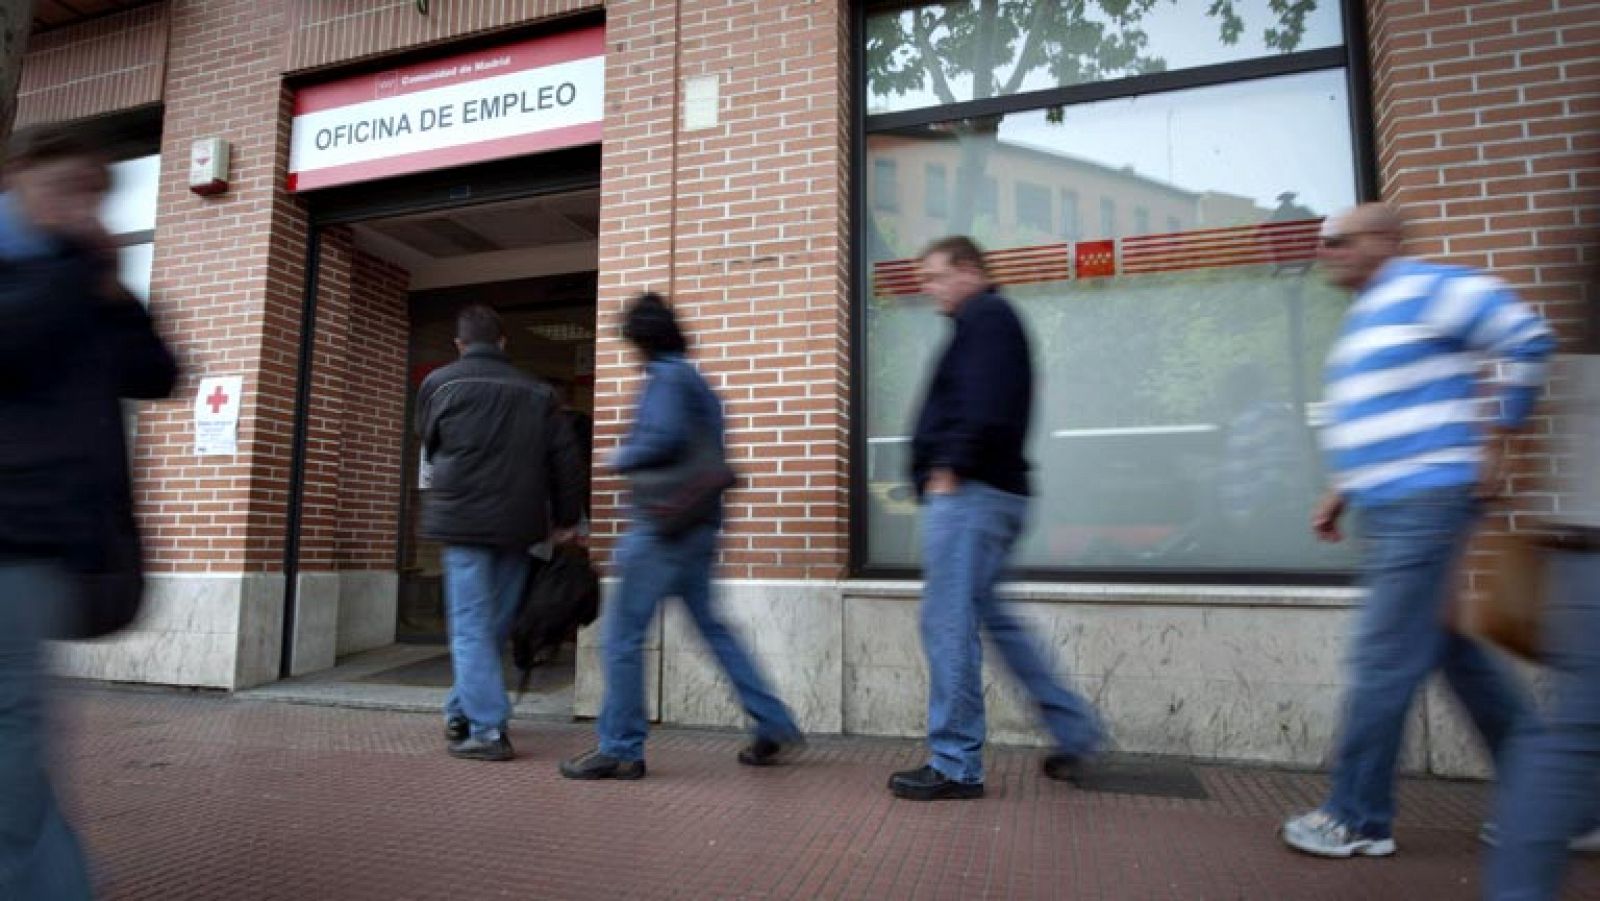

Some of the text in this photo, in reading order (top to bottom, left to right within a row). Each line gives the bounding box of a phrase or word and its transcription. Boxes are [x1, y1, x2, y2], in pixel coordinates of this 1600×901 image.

[475, 56, 511, 71] Madrid
[315, 82, 576, 150] OFICINA DE EMPLEO
